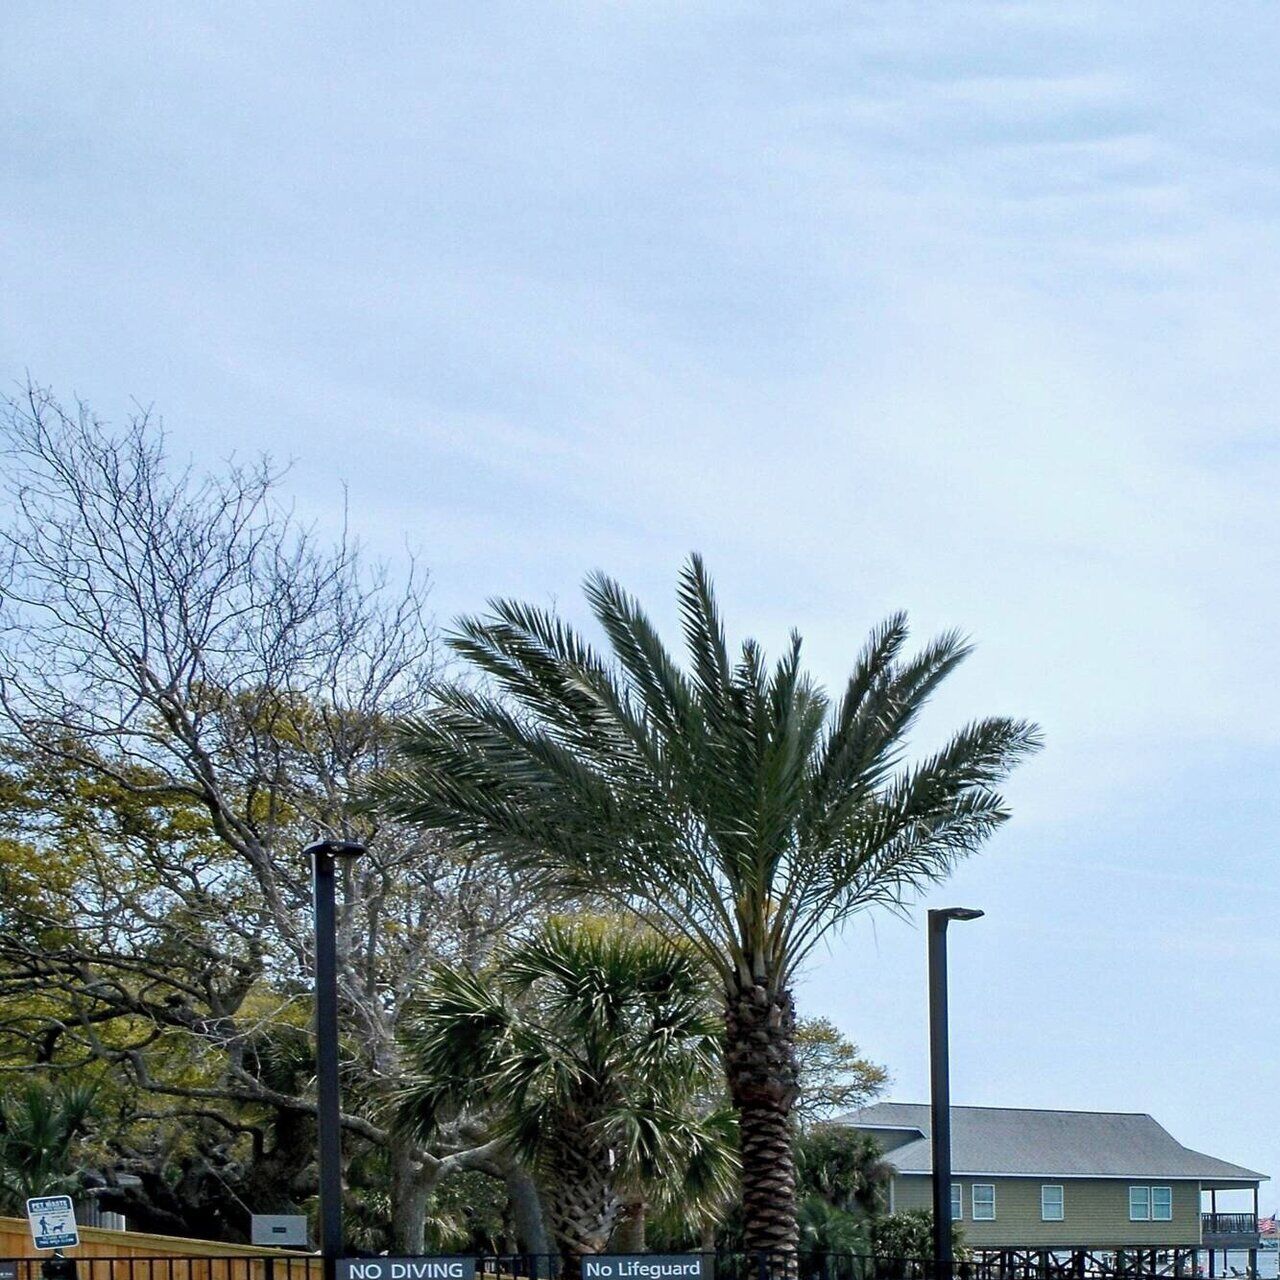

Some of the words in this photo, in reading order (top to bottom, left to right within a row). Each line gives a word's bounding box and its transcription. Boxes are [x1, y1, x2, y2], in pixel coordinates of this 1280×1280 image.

[349, 1264, 382, 1280] NO
[391, 1263, 463, 1279] DIVING
[586, 1262, 613, 1277] No
[618, 1260, 701, 1280] Lifeguard
